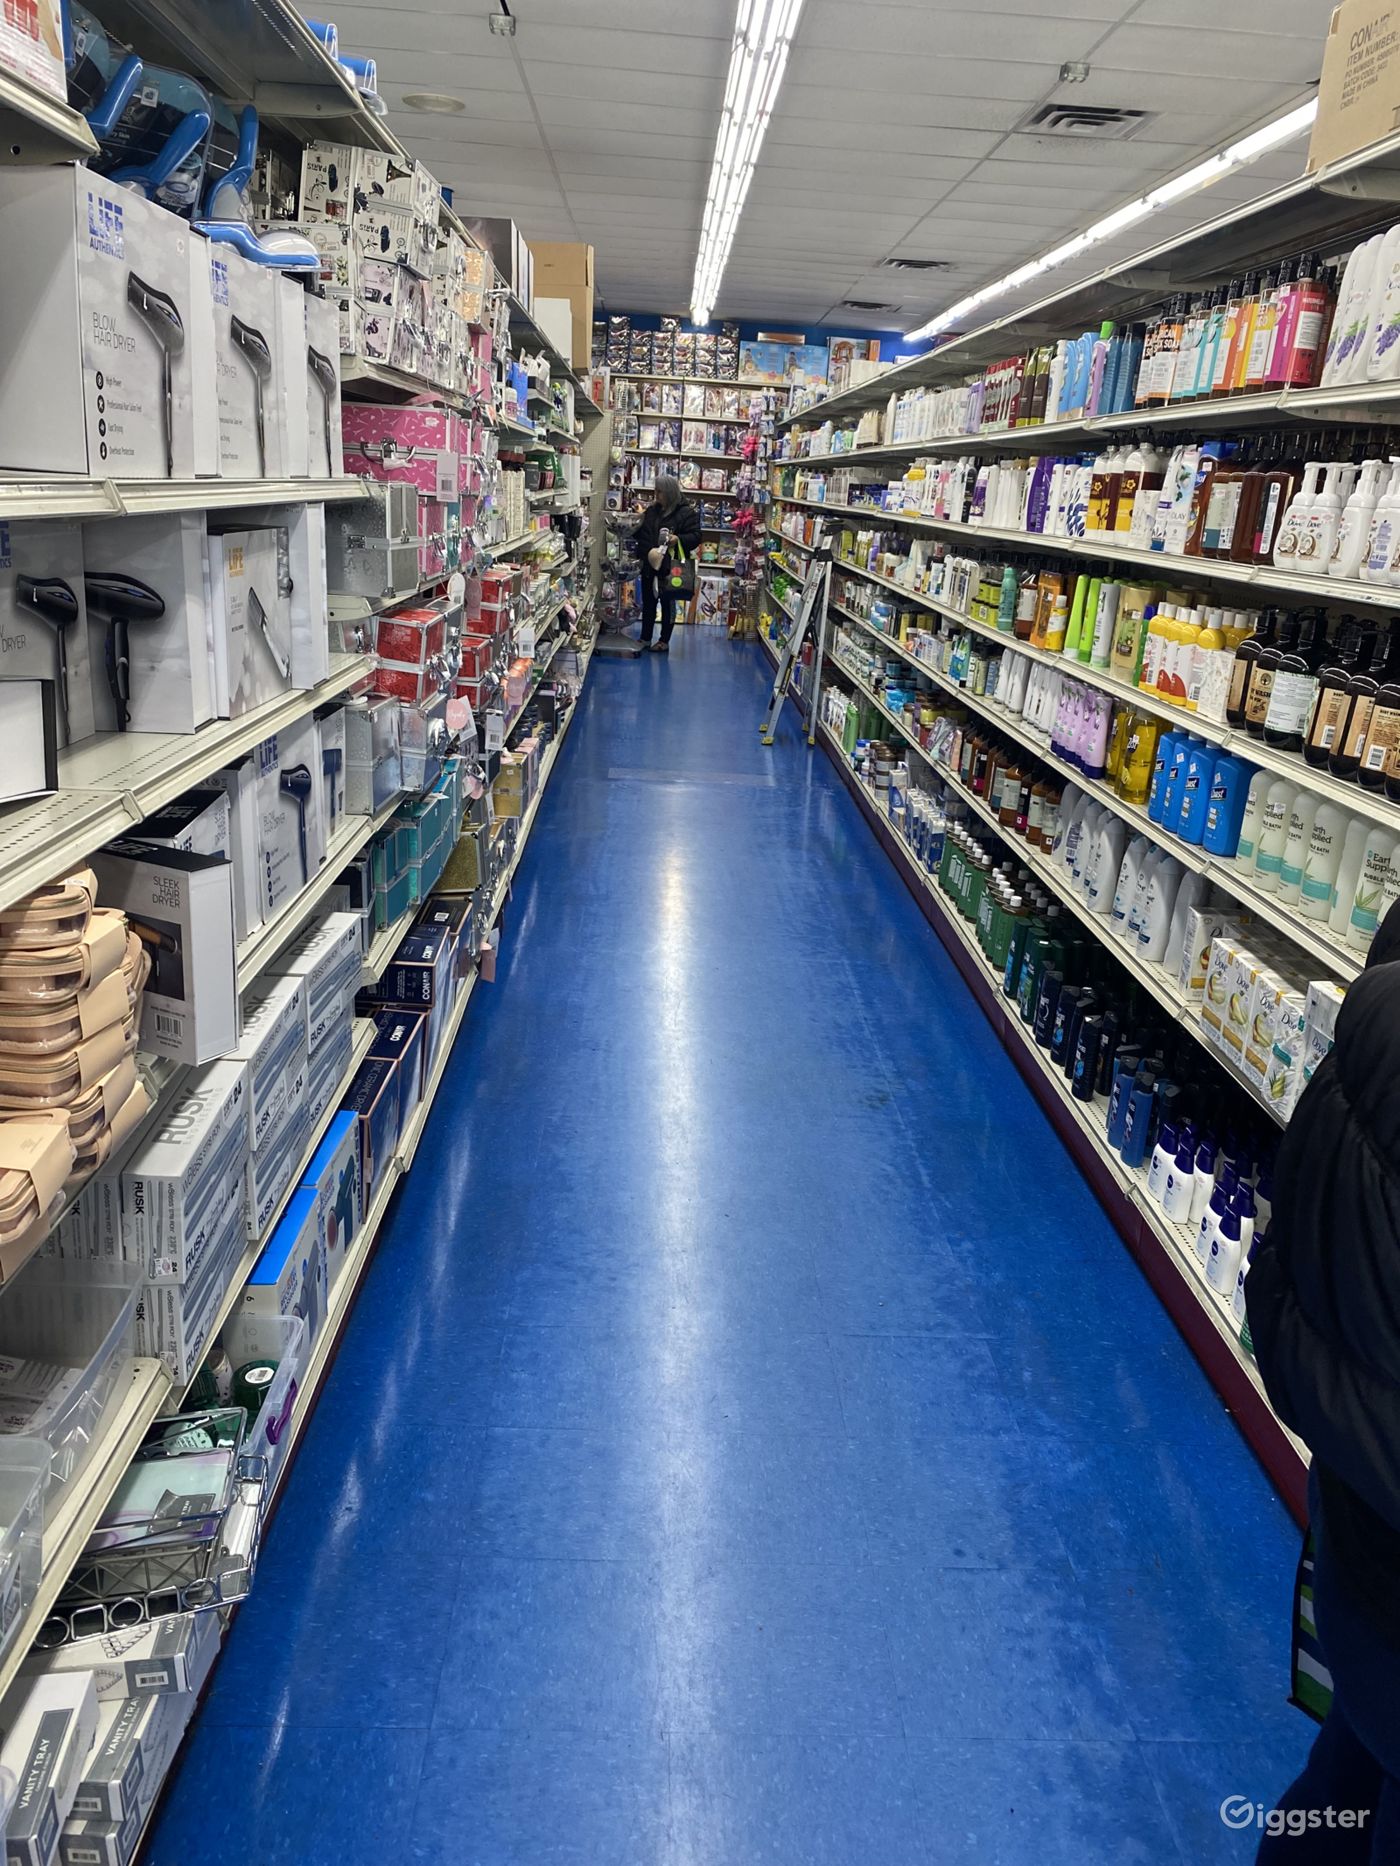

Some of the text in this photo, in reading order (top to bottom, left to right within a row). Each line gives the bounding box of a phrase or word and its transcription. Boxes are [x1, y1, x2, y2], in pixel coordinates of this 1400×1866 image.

[1347, 52, 1363, 67] ITEM
[307, 163, 328, 174] PARIS
[359, 223, 380, 234] PARIS
[93, 311, 116, 331] BLOW
[94, 329, 136, 353] HAIR DRYER
[1171, 511, 1186, 519] OLAY
[1307, 520, 1322, 528] Dove
[1, 634, 26, 653] DRYER
[1313, 825, 1326, 835] arth
[1317, 846, 1330, 854] BATH
[1366, 859, 1387, 873] Supp
[153, 876, 180, 889] SLEEK
[152, 894, 181, 909] DRYER
[160, 887, 180, 899] HAIR
[289, 926, 335, 957] RUSK
[347, 926, 356, 942] 24
[1214, 954, 1229, 972] Dove
[421, 971, 431, 1000] CONAIR
[1236, 973, 1250, 992] Dove
[291, 991, 300, 1006] 24
[1260, 995, 1275, 1014] Dove
[310, 1017, 326, 1046] RUSK
[1281, 1013, 1298, 1031] Dove
[1311, 1036, 1327, 1057] Dove
[233, 1080, 243, 1104] 24
[152, 1086, 214, 1146] RUSK
[310, 1099, 323, 1123] RUSK
[255, 1105, 271, 1138] RUSK
[134, 1181, 145, 1215] RUSK
[258, 1200, 274, 1228] RUSK
[185, 1230, 205, 1269] RUSK
[171, 1261, 178, 1273] 24
[185, 1331, 205, 1372] RUSK
[164, 1617, 177, 1635] VAN
[105, 1719, 129, 1756] VANITY
[19, 1767, 40, 1809] VANITY
[33, 1738, 51, 1768] TRAY
